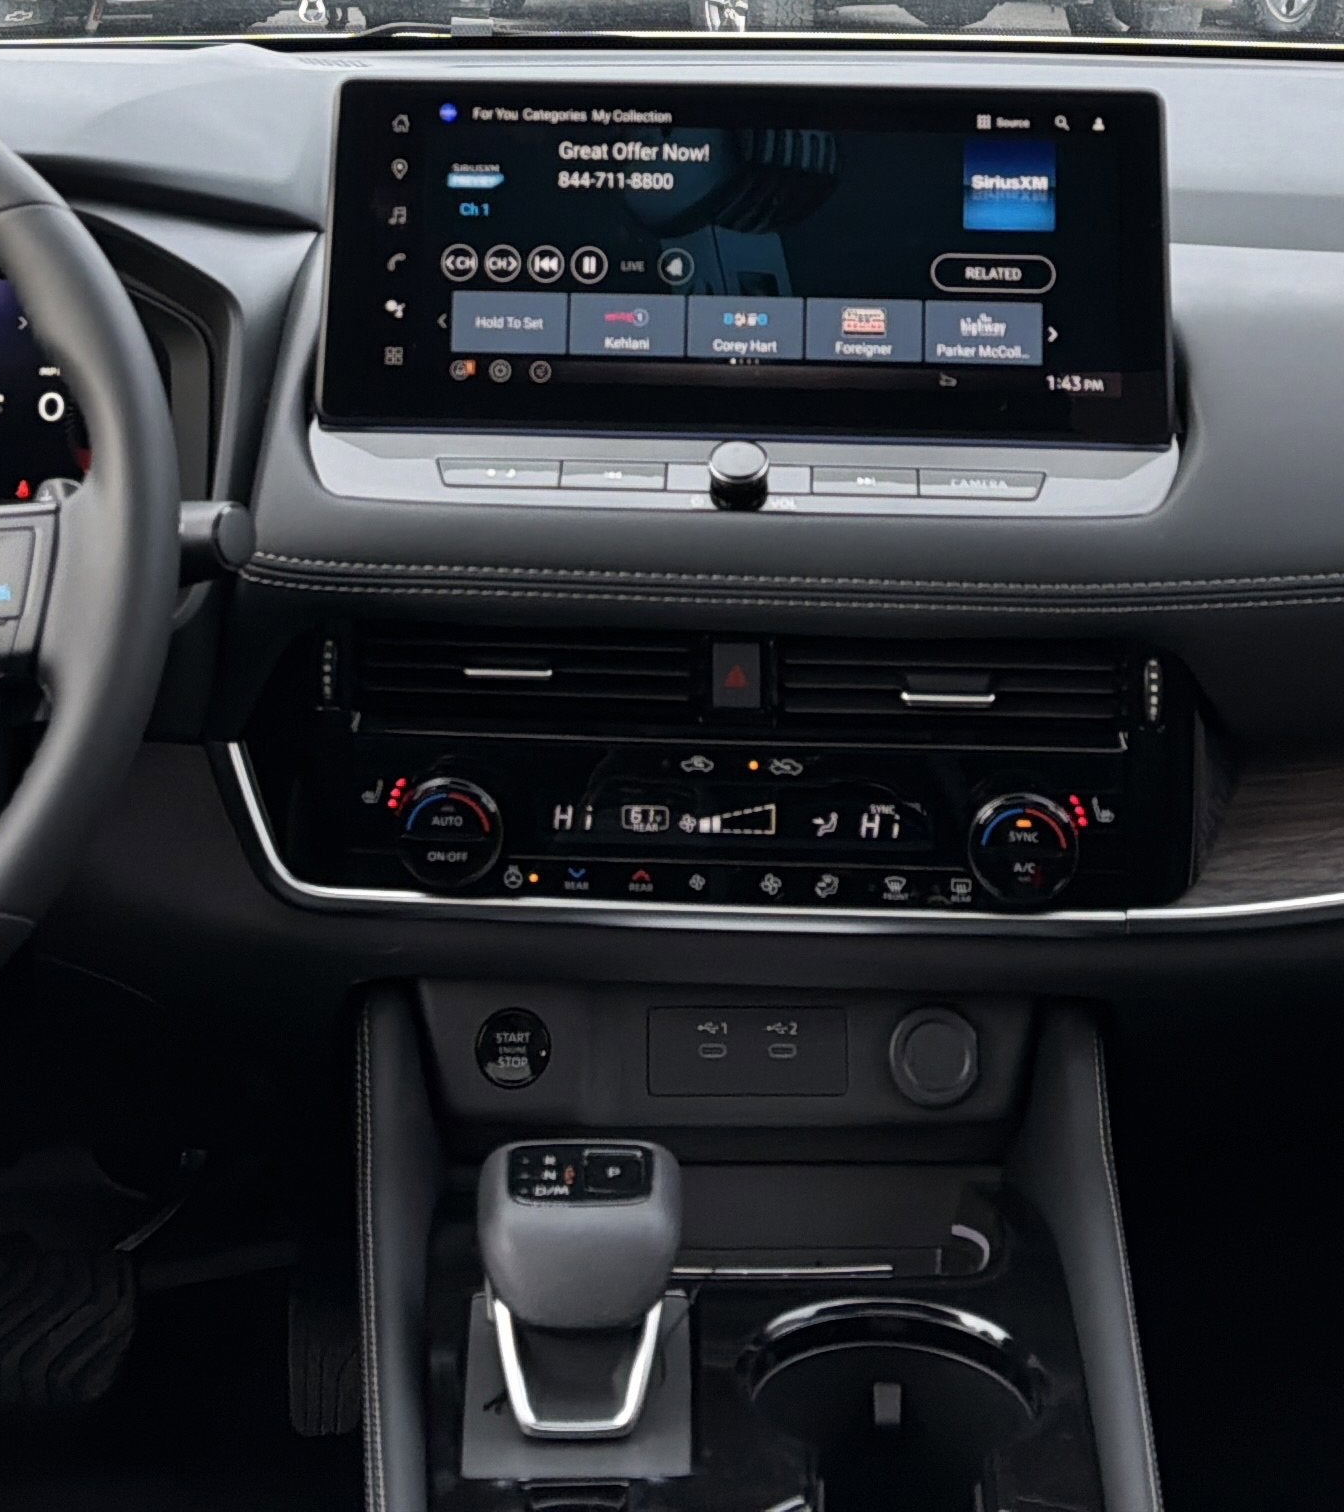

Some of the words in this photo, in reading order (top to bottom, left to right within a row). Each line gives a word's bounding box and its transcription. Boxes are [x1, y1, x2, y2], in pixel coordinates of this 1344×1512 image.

[472, 107, 493, 121] For
[496, 108, 519, 122] You
[522, 108, 587, 124] Categories
[591, 109, 612, 125] My
[613, 109, 672, 124] Collection
[996, 117, 1031, 129] Source
[558, 141, 608, 160] Great
[612, 142, 659, 161] Offer
[662, 143, 710, 162] Now!
[557, 171, 674, 190] 844-711-8800
[971, 175, 1049, 191] SiriusXM
[459, 203, 479, 216] Ch
[482, 203, 490, 216] 1
[621, 261, 645, 272] LIVE
[965, 267, 1022, 281] RELATED
[475, 315, 504, 330] Hold
[506, 316, 522, 330] To
[524, 316, 544, 331] Set
[605, 336, 650, 351] Kehlani
[712, 338, 747, 356] Corey
[750, 339, 777, 354] Hart
[835, 342, 893, 358] Foreigner
[936, 343, 975, 358] Parker
[1045, 375, 1081, 391] 1:43
[1084, 379, 1105, 392] PM
[38, 391, 65, 422] 0
[772, 498, 796, 509] VOL
[553, 803, 593, 830] Hi
[869, 805, 896, 815] SYNC
[431, 816, 464, 827] AUTO
[632, 823, 659, 833] REAR
[1009, 832, 1039, 843] SYNC
[1013, 862, 1036, 874] A/C
[629, 883, 654, 893] REAR
[721, 1022, 728, 1035] 1
[789, 1022, 798, 1035] 2
[495, 1032, 531, 1044] START
[497, 1056, 528, 1069] STOP
